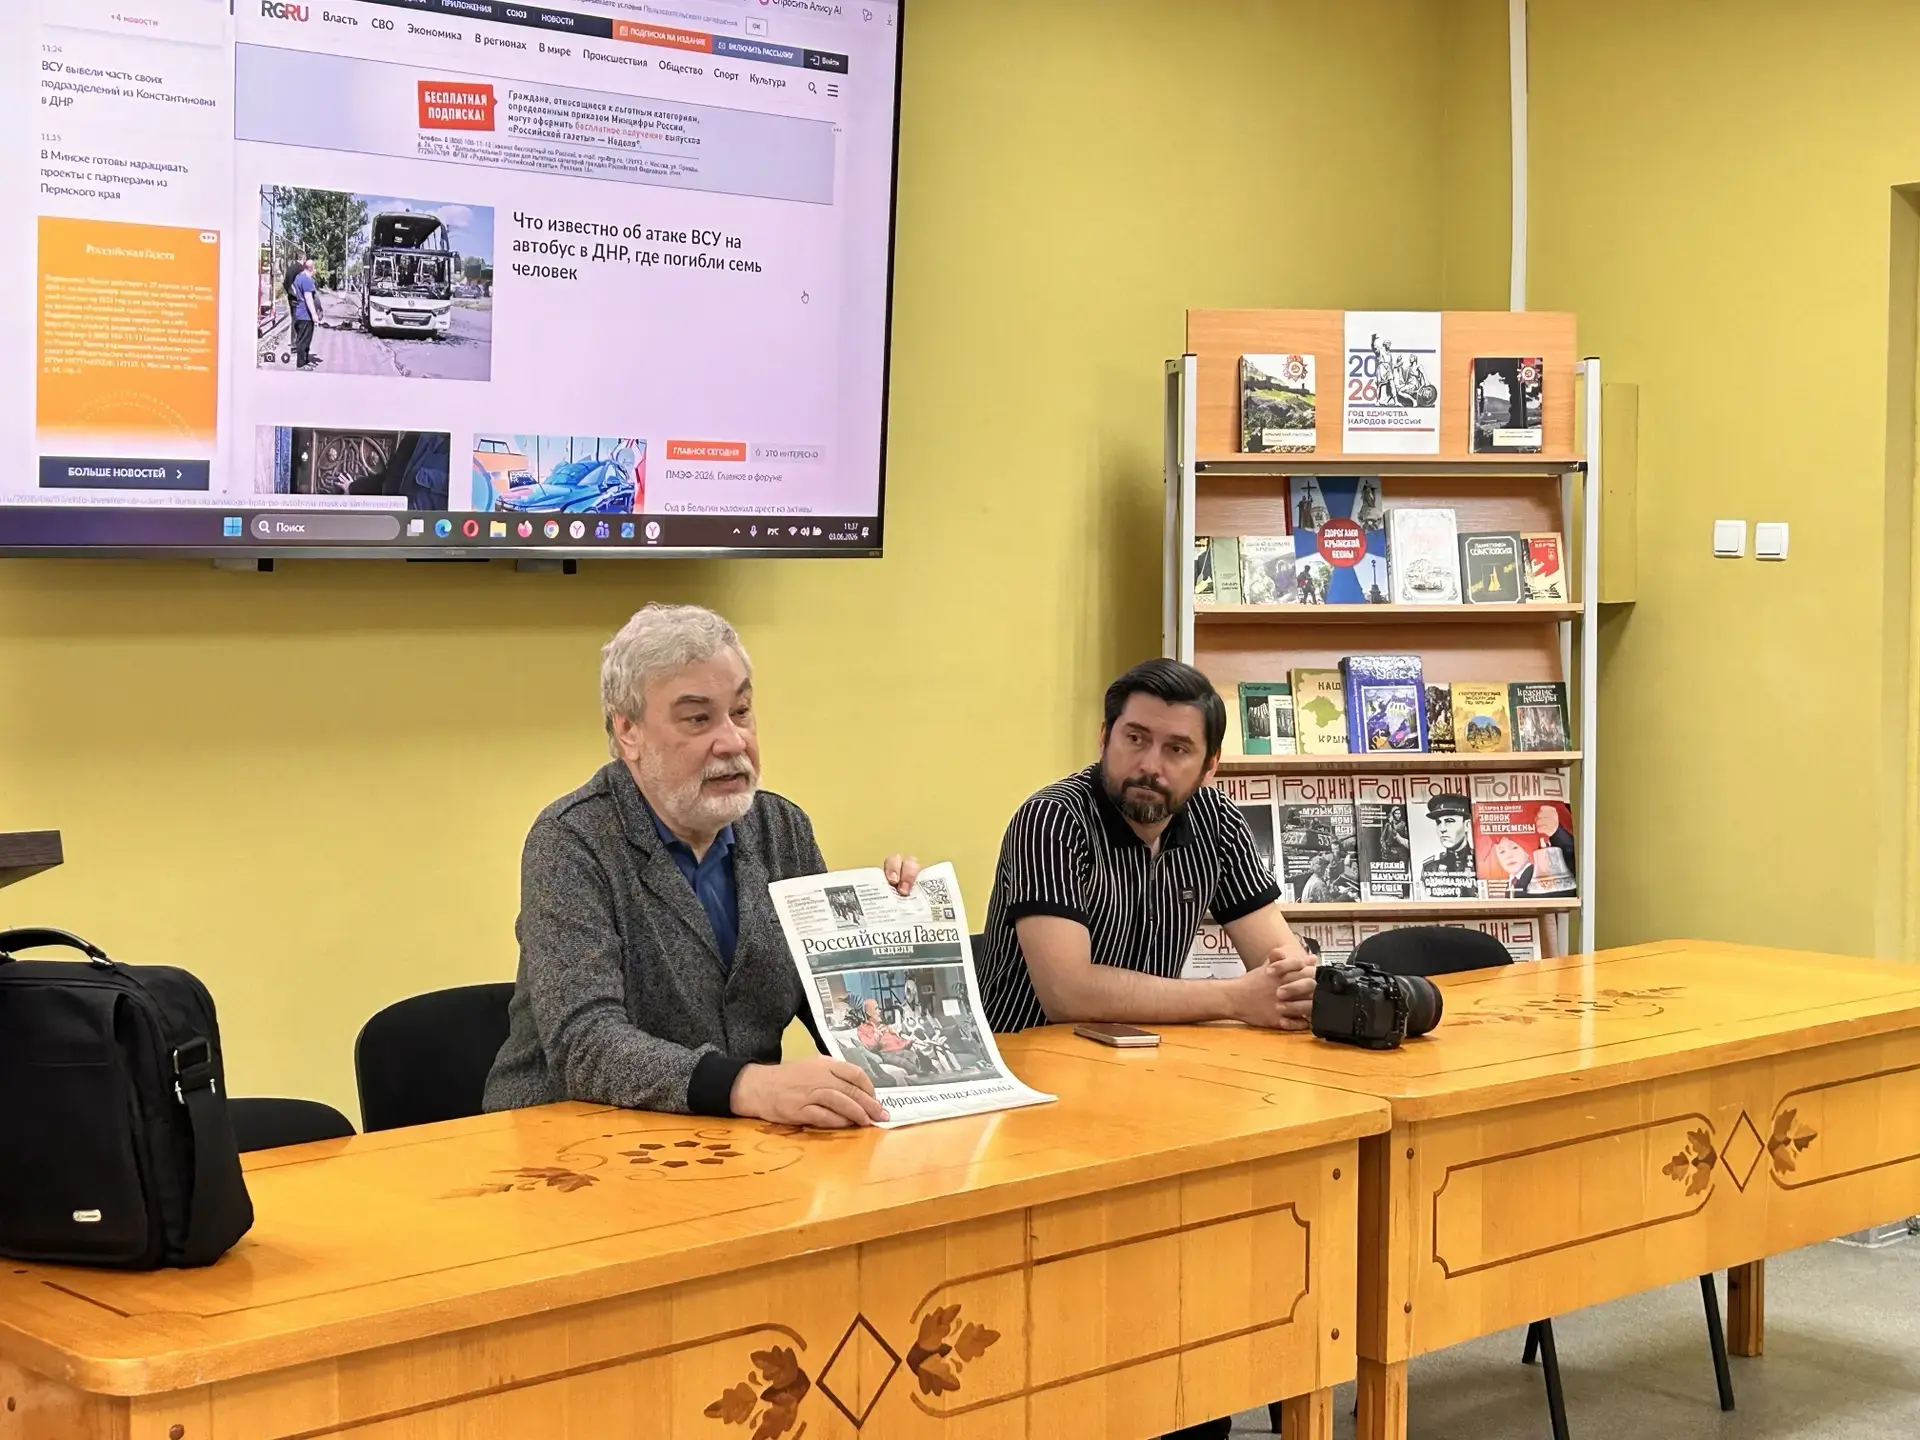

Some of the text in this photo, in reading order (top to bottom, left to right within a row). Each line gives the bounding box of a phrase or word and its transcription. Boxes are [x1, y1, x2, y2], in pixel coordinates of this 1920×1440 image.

[260, 1, 309, 22] RGRU
[506, 8, 528, 19] СОЮЗ
[809, 3, 833, 16] Алису
[322, 11, 358, 26] Власть
[371, 18, 394, 31] СВО
[541, 14, 574, 26] НОВОСТИ
[407, 24, 462, 41] Экономика
[475, 34, 527, 50] В регионах
[538, 42, 572, 57] В мире
[583, 48, 648, 68] Происшествия
[41, 60, 163, 84] ВСУ вывели часть своих
[658, 60, 703, 76] Общество
[714, 68, 740, 83] Спорт
[749, 72, 786, 88] Культура
[41, 79, 216, 108] подразделений из Константиновки
[424, 91, 488, 106] БЕСПЛАТНАЯ
[508, 90, 552, 105] Граждане,
[553, 98, 606, 111] относящиеся
[48, 96, 74, 108] ДНР
[428, 106, 485, 121] ПОДПИСКА!
[508, 115, 532, 125] могут
[532, 116, 574, 130] оформить
[574, 121, 620, 135] бесплатное
[571, 112, 610, 123] приказом
[611, 114, 654, 129] Минцифры
[656, 120, 686, 134] России,
[563, 132, 596, 142] газеты»
[40, 149, 188, 174] В Минске готовы наращивать
[40, 168, 168, 188] проекты с партнерами из
[40, 183, 121, 200] Пермского края
[512, 212, 742, 249] Что известно об атаке ВСУ на
[512, 238, 762, 274] автобус в ДНР, где погибли семь
[512, 262, 578, 280] человек
[1348, 355, 1378, 378] 20
[1348, 378, 1378, 401] 26
[1348, 410, 1408, 418] ГОД ЕДИНСТВА
[1348, 418, 1386, 426] НАРОДОВ
[673, 446, 740, 457] ГЛАВНОЕ СЕГОДНЯ
[765, 450, 778, 458] ЭТО
[68, 466, 166, 479] БОЛЬШЕ НОВОСТЕЙ
[717, 471, 746, 482] Главное
[748, 474, 754, 482] о
[754, 473, 782, 483] форуме
[664, 502, 680, 514] Суд
[754, 505, 775, 514] арест
[276, 522, 306, 534] Поиск
[767, 526, 780, 536] РУС
[1283, 778, 1352, 803] РОДИН
[1478, 814, 1510, 822] ЗВОНОК
[1480, 824, 1536, 832] НА ПЕРЕМЕНЫ
[800, 925, 960, 954] Российская Газета
[872, 945, 914, 956] НЕДЕЛЯ
[878, 1084, 1016, 1108] ифровые подхалимы
